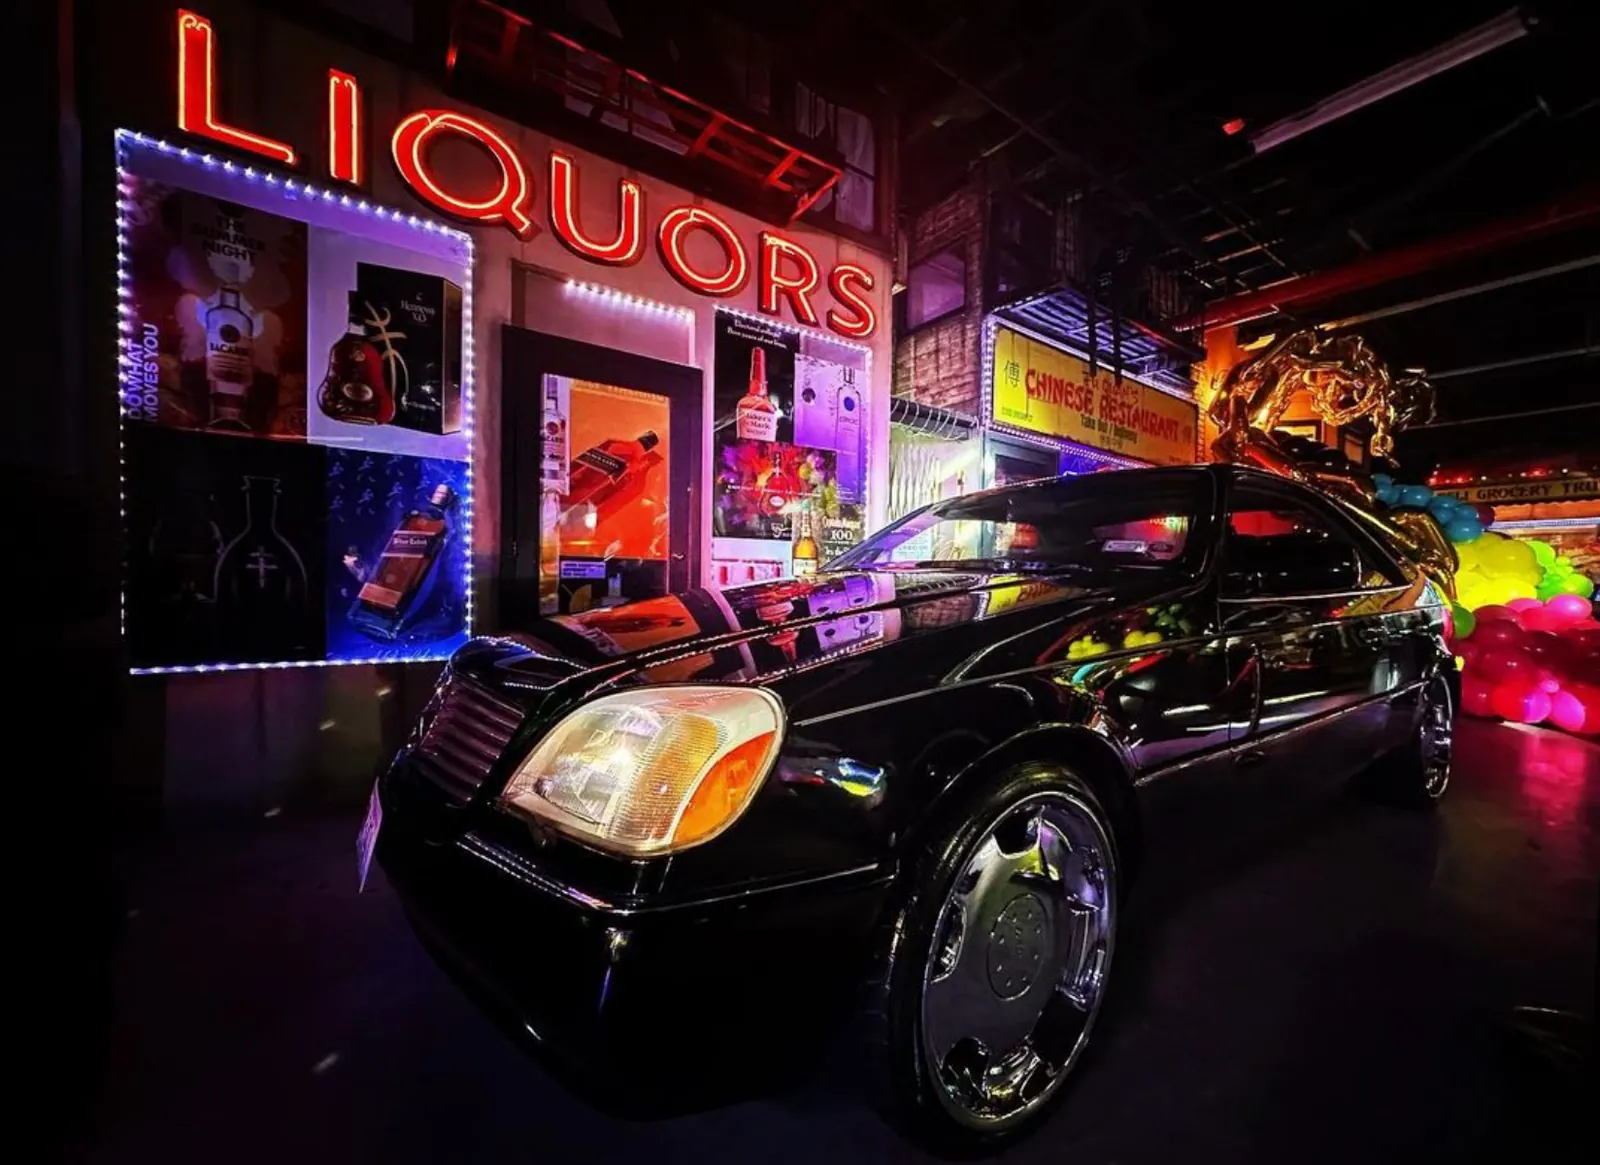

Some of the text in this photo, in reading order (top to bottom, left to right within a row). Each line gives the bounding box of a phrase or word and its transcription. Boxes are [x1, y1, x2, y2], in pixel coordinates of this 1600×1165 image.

[175, 8, 879, 338] LIQUORS
[202, 240, 258, 264] NIGHT
[127, 338, 143, 394] WHAT
[143, 322, 159, 422] MOVES YOU
[1024, 367, 1180, 443] CHINESE RESTAURANT
[1476, 485, 1550, 500] GROCERY
[830, 528, 854, 541] 100
